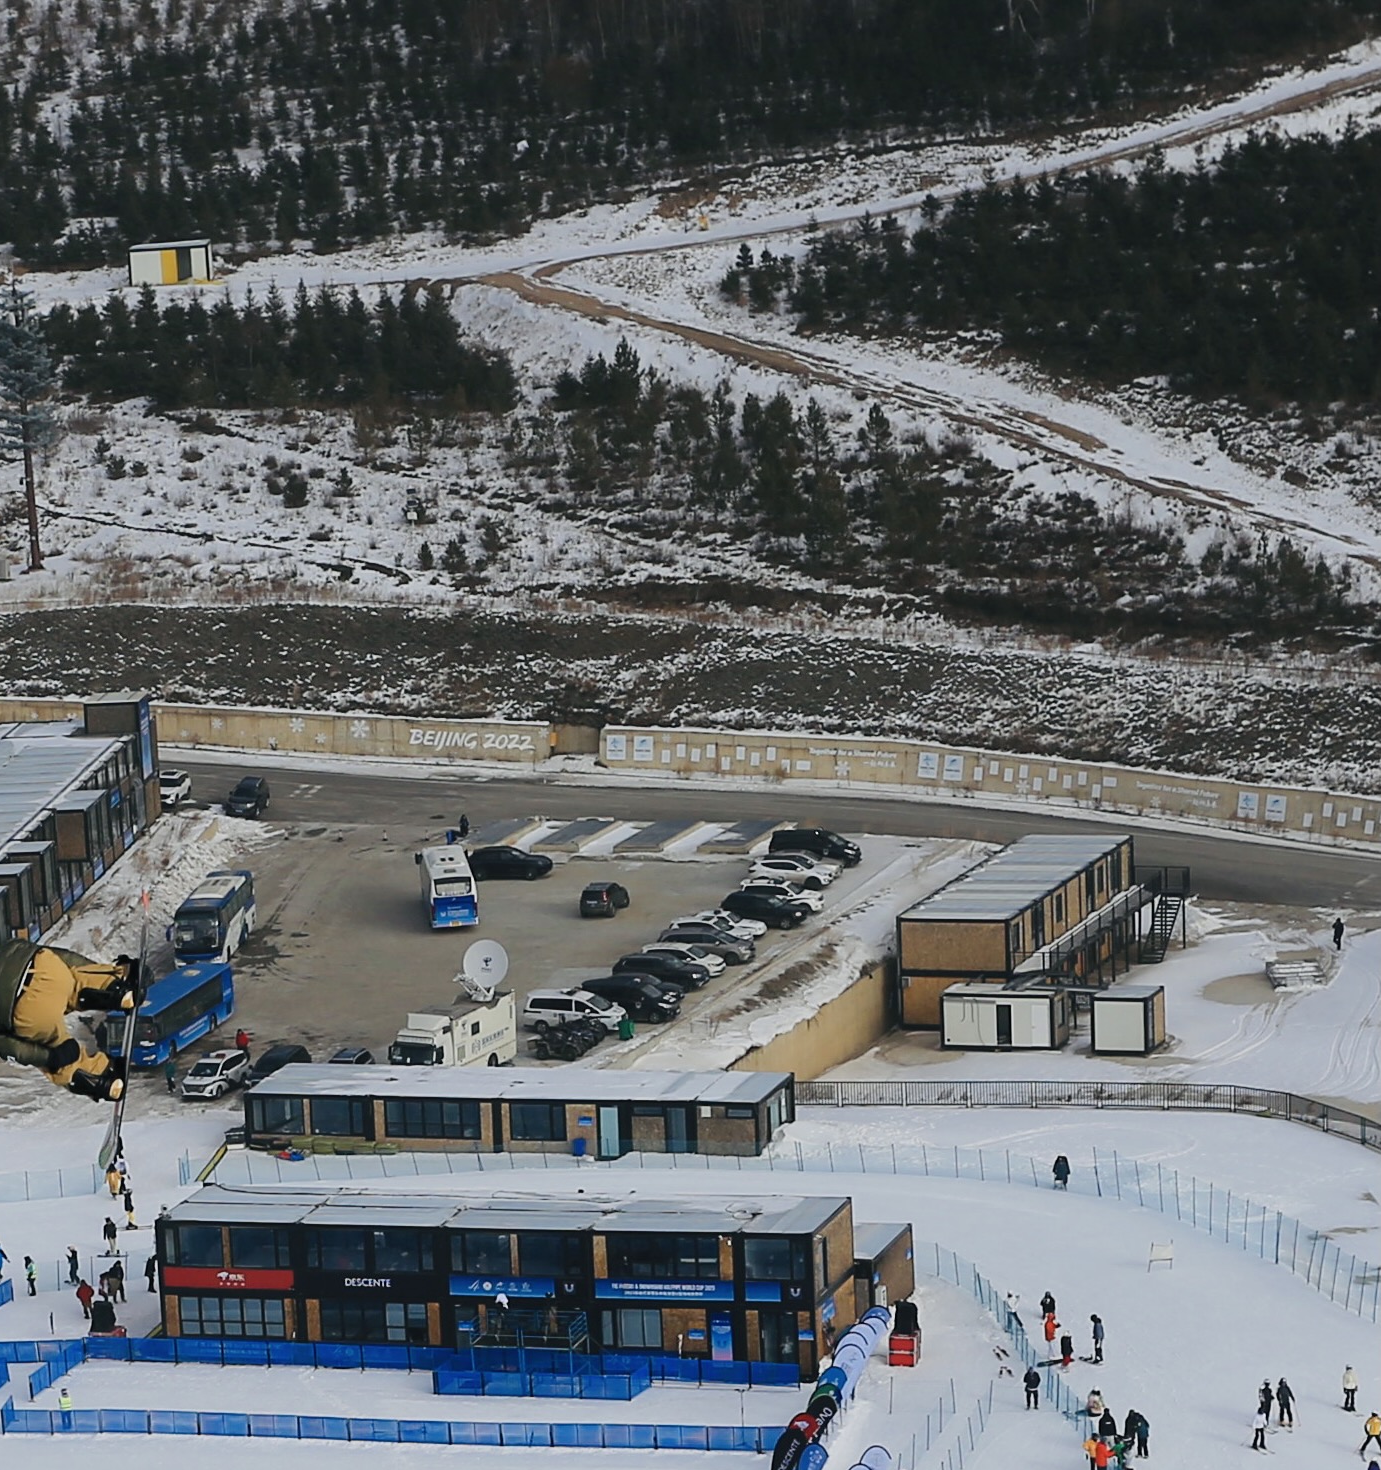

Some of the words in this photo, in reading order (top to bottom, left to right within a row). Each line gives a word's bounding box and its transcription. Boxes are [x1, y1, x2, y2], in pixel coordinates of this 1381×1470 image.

[409, 729, 478, 751] BEIJING
[482, 733, 536, 751] 2022
[344, 1277, 391, 1288] DESCENTE
